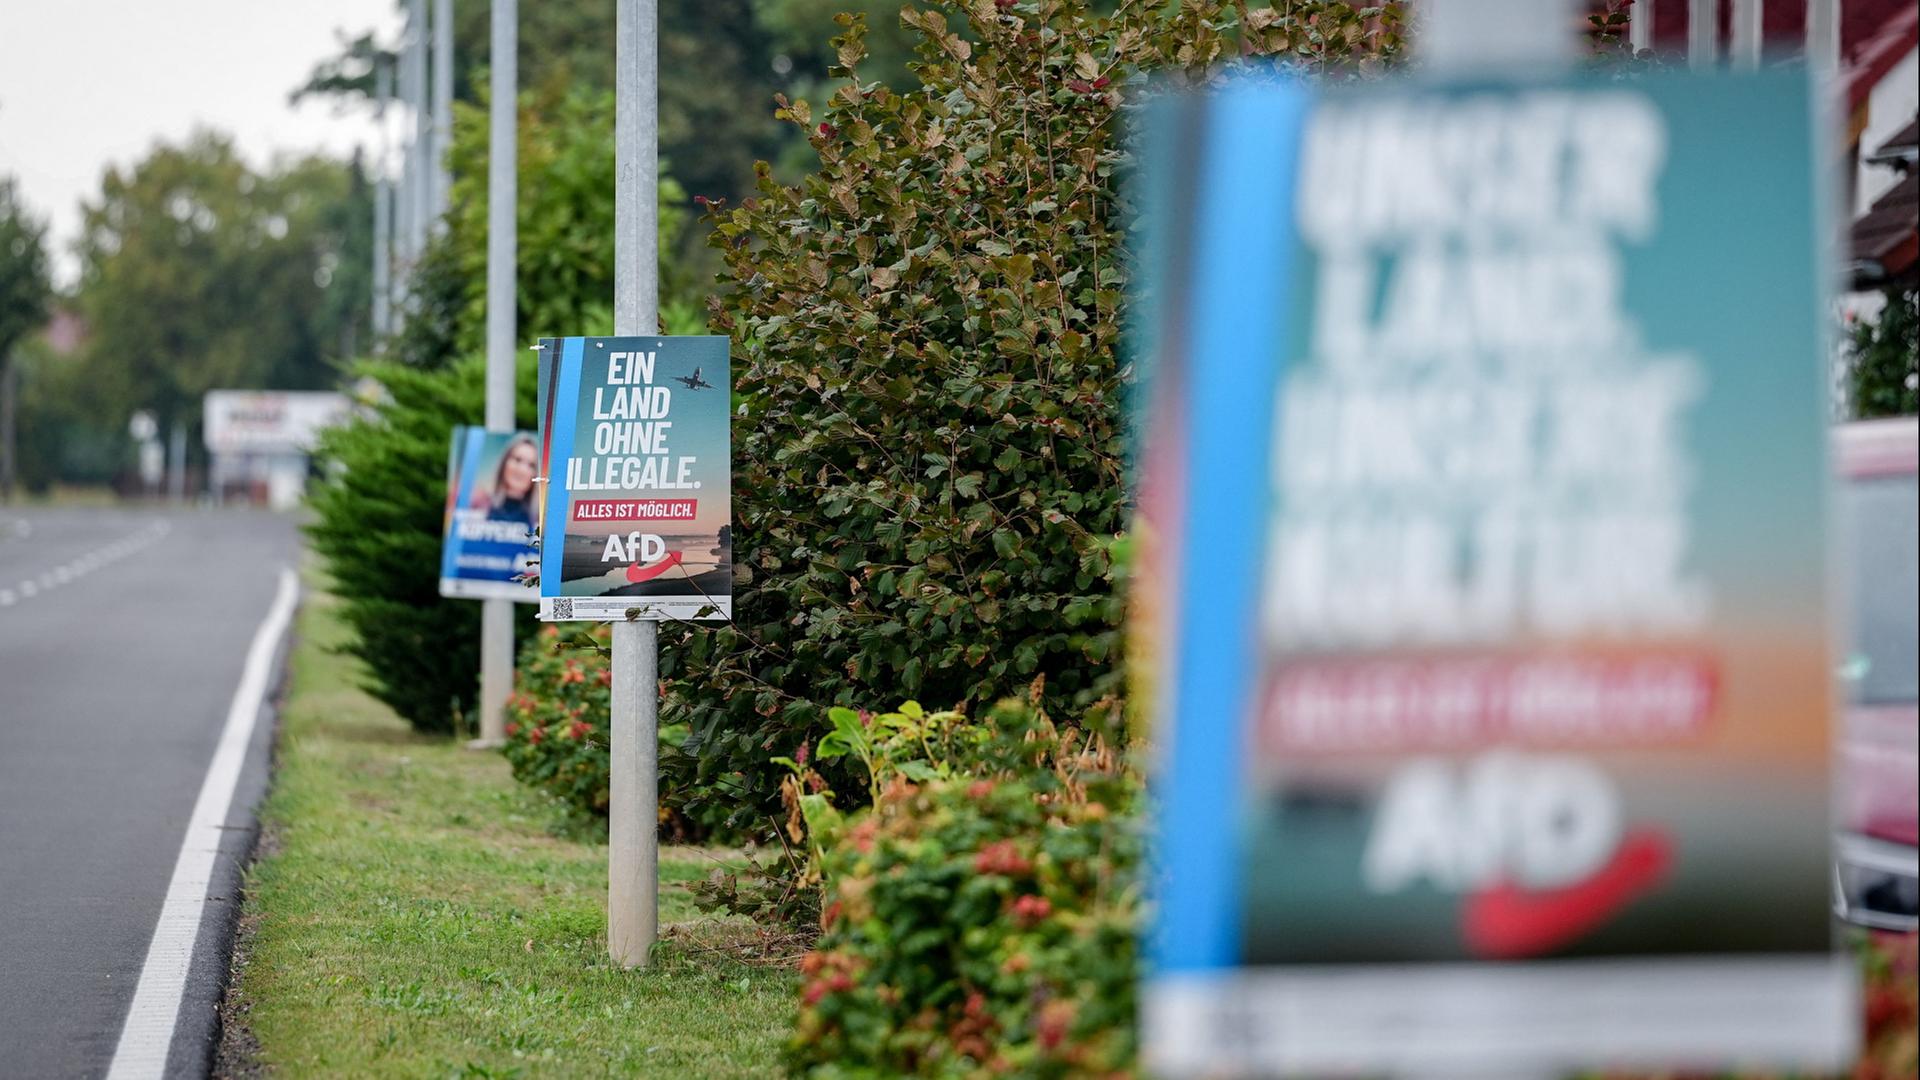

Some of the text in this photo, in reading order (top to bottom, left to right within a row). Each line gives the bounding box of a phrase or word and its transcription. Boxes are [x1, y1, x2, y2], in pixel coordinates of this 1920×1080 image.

[607, 352, 656, 385] EIN
[593, 387, 671, 420] LAND
[594, 421, 672, 455] OHNE
[565, 456, 701, 490] ILLEGALE.
[577, 501, 693, 518] ALLES IST MÖGLICH.
[601, 531, 665, 562] AfD
[1363, 752, 1622, 892] AfD
